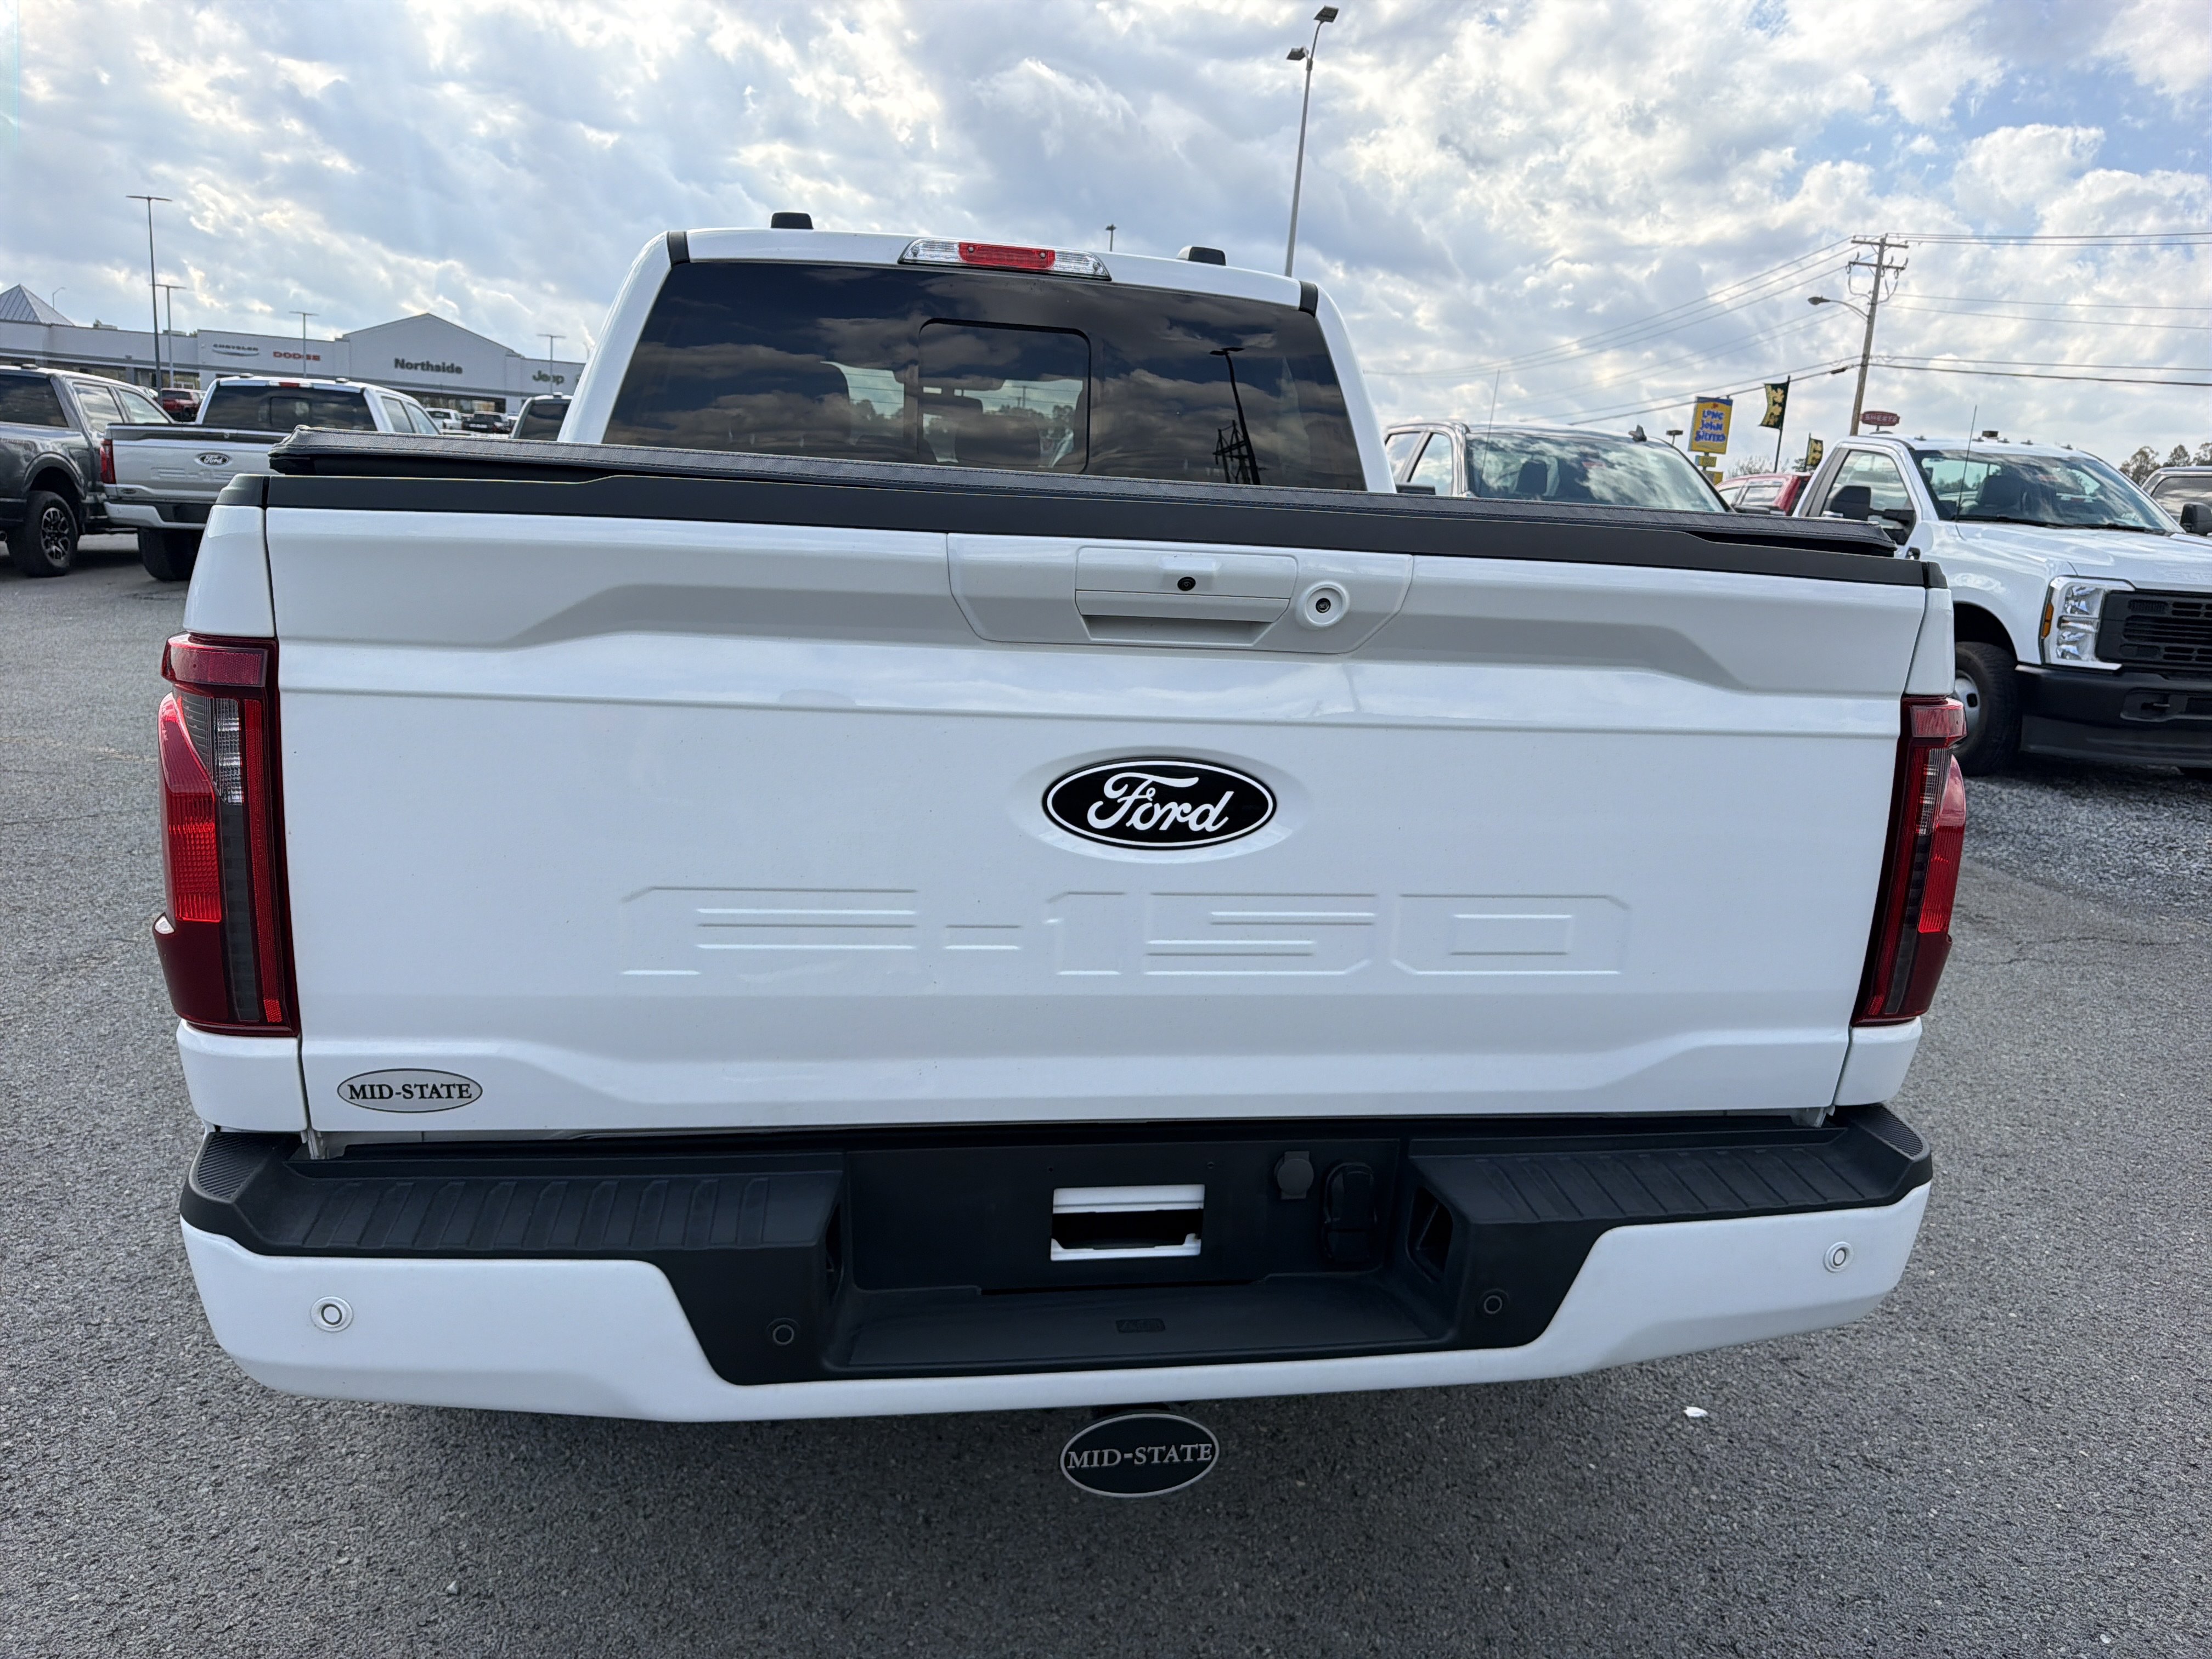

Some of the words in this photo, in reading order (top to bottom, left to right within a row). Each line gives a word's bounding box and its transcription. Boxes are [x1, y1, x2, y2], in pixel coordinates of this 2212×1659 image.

[394, 357, 463, 374] Northside
[532, 370, 564, 385] Jeep
[1702, 409, 1724, 421] LONG
[203, 454, 223, 464] Ford
[1087, 772, 1234, 832] Ford
[620, 884, 1632, 976] F-150
[347, 1083, 472, 1100] MID-STATE
[1067, 1443, 1212, 1469] MID-STATE
